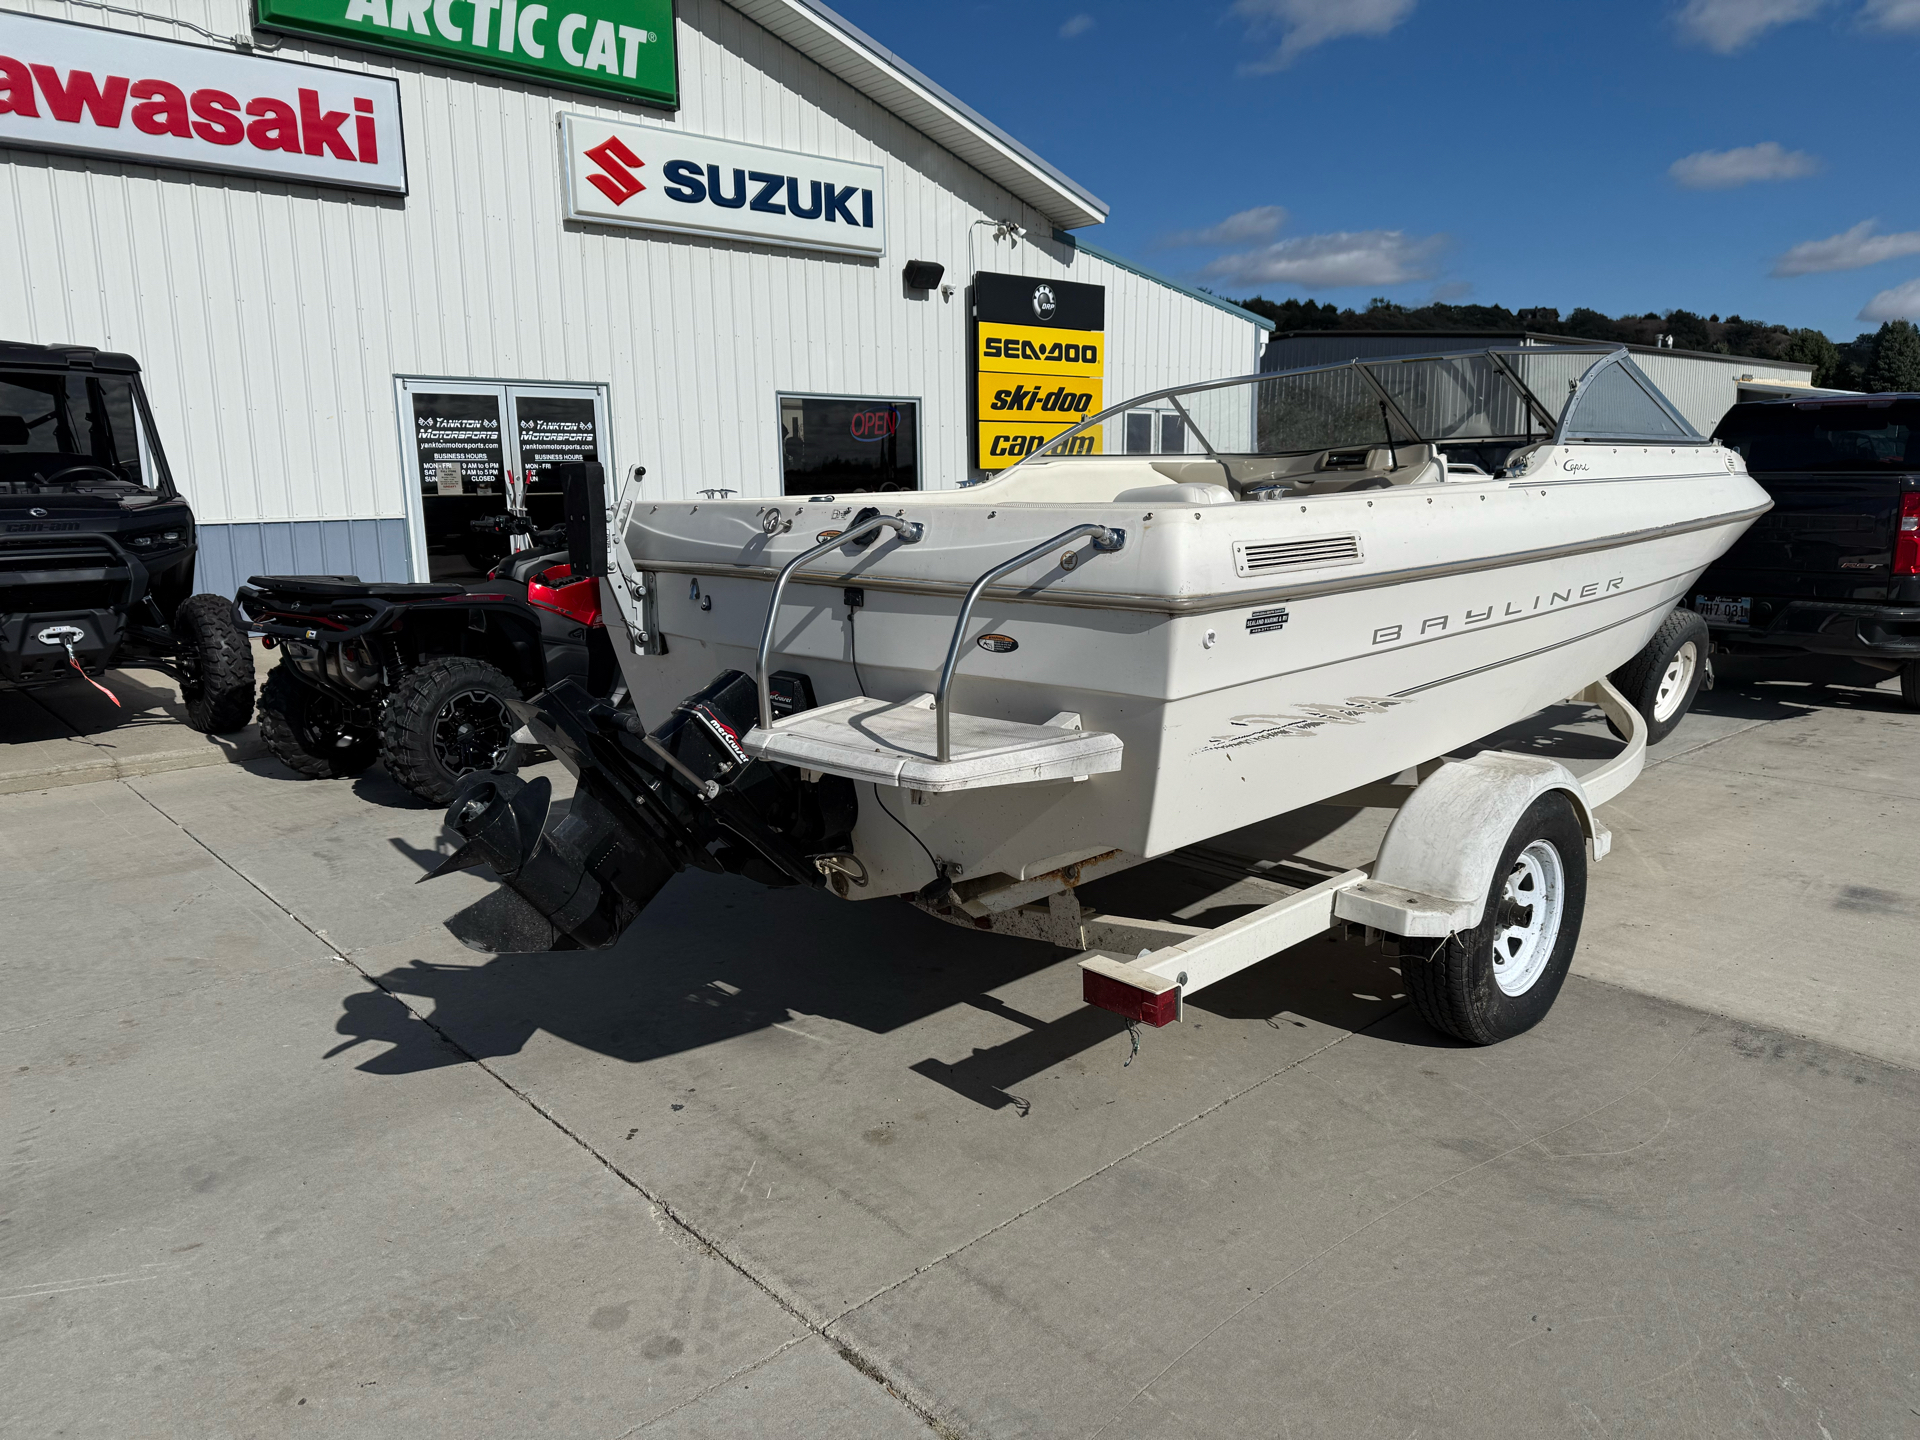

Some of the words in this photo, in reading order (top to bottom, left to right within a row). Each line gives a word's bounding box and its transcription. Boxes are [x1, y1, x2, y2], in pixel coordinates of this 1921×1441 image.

[662, 159, 874, 229] SUZUKI
[990, 384, 1093, 413] ski-doo
[436, 418, 482, 428] YANKTON
[537, 420, 579, 430] YANKTON
[851, 412, 896, 436] OPEN
[418, 429, 499, 439] MOTORSPORTS
[520, 431, 594, 441] MOTORSPORTS
[420, 442, 499, 450] yanktonmotorsports.com
[522, 443, 594, 451] yanktonmotorsports.com
[1562, 459, 1590, 475] Capri
[5, 521, 80, 533] can-am
[1840, 562, 1884, 570] RST
[555, 606, 568, 614] XT
[1371, 577, 1625, 646] BAYLINER
[1699, 603, 1720, 616] 7H7
[1724, 604, 1745, 617] 031
